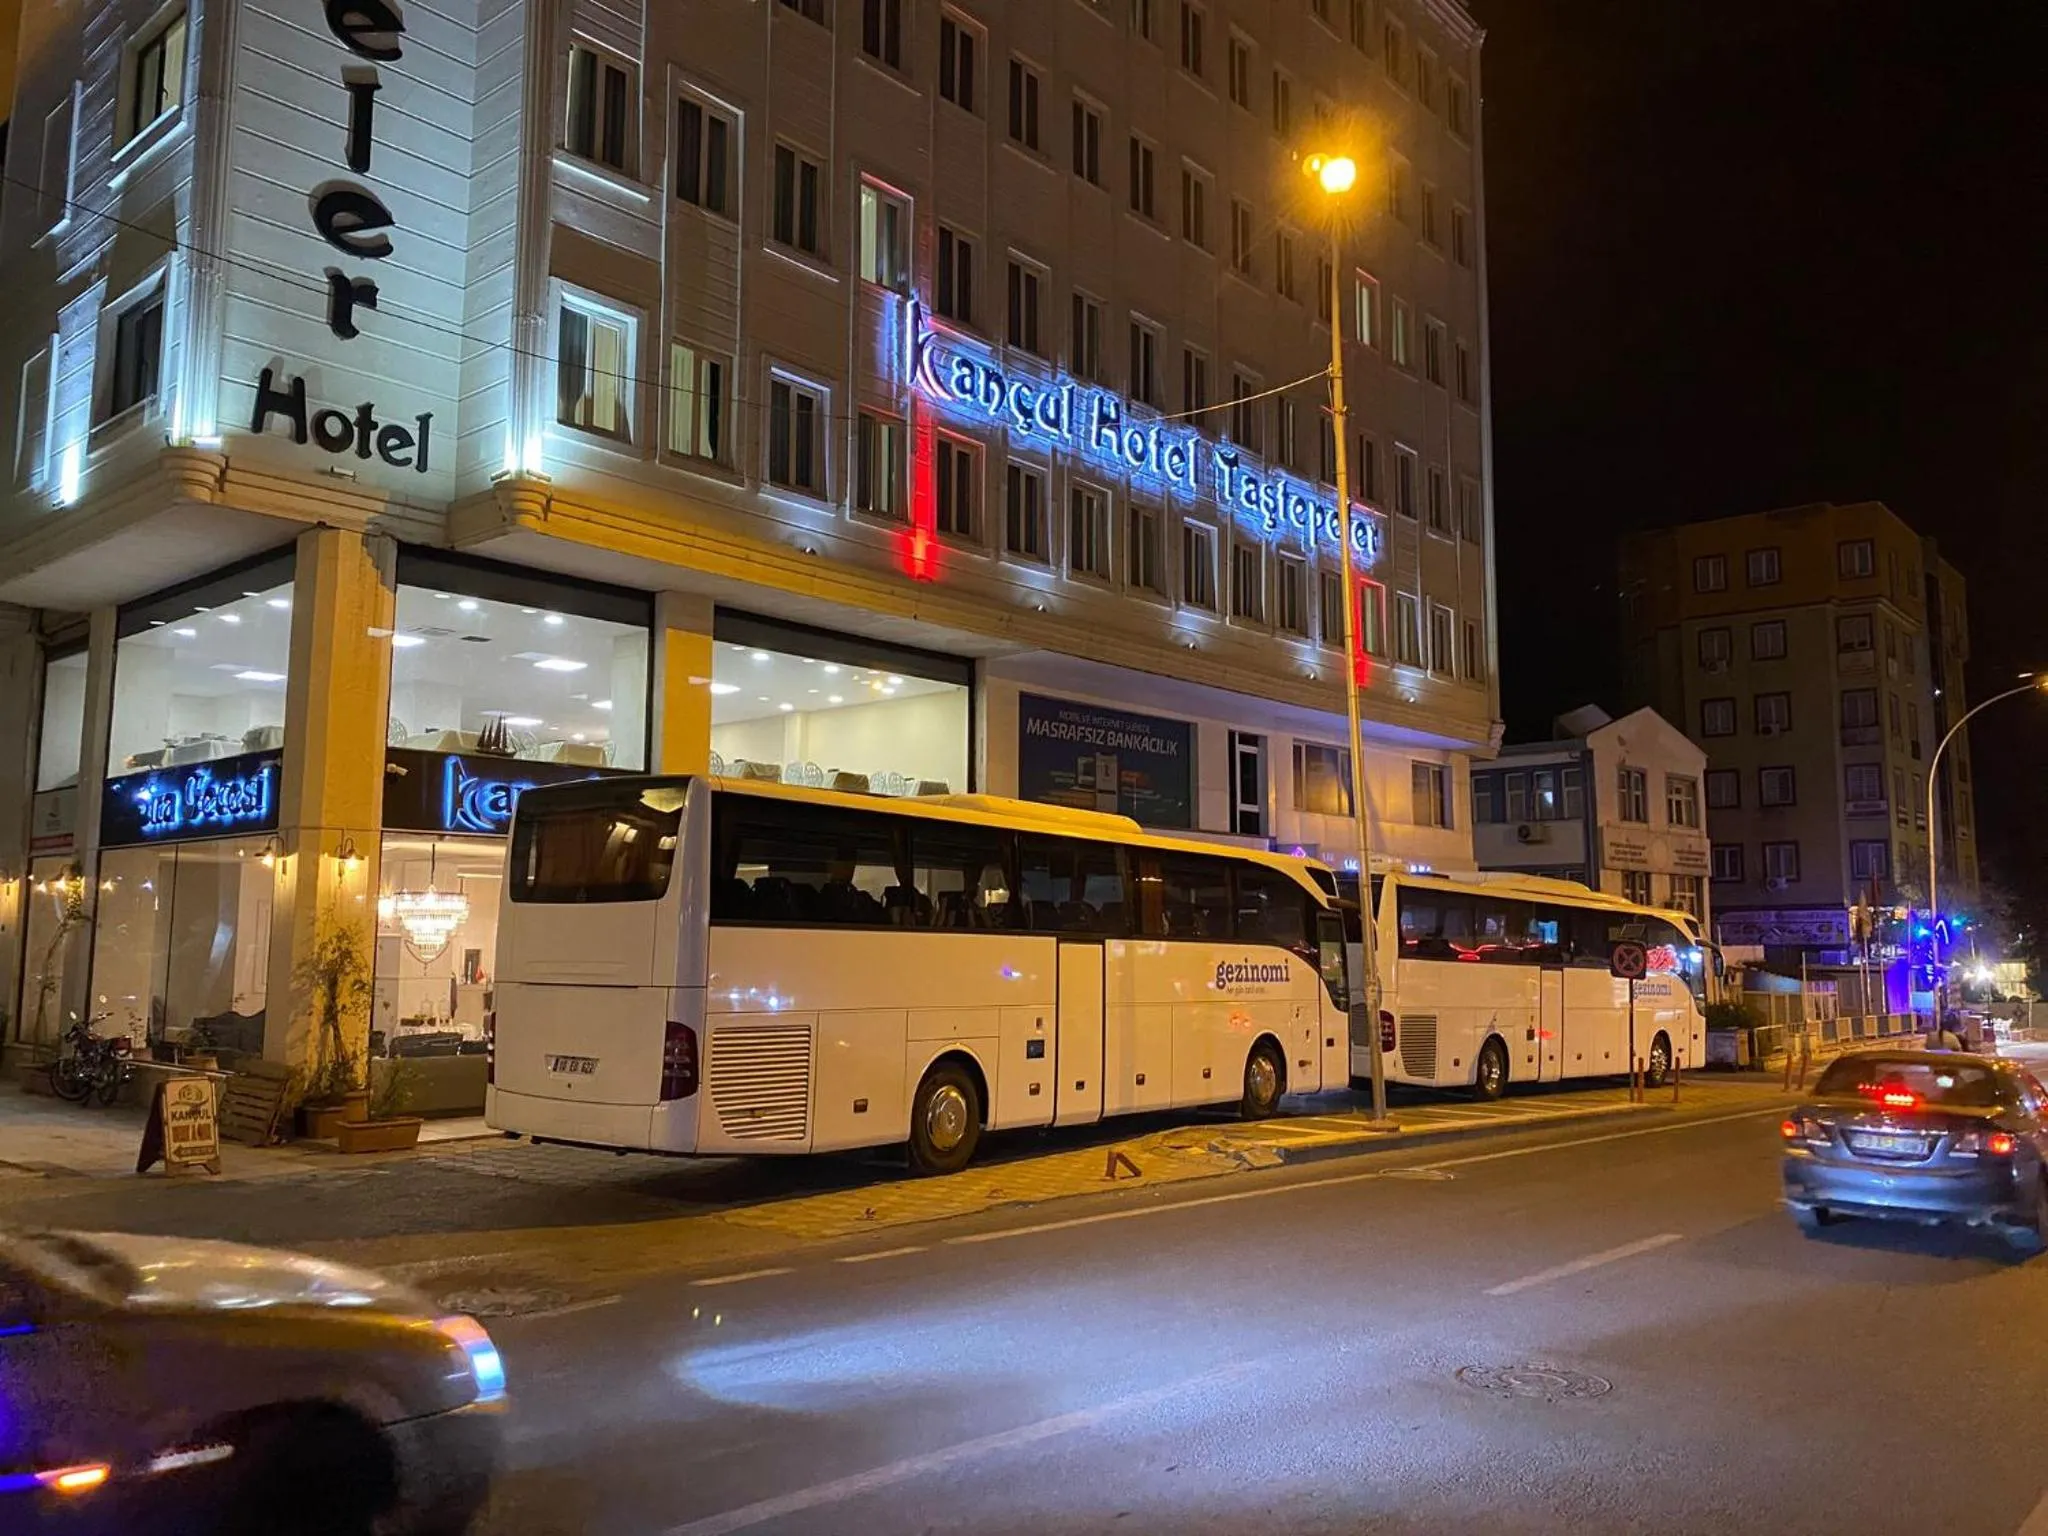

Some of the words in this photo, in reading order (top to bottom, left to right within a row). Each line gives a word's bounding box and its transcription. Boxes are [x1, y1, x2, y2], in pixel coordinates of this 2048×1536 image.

[251, 366, 434, 473] Hotel
[1091, 394, 1199, 488] Hotel
[1026, 717, 1104, 746] MASRAFSIZ
[1107, 731, 1179, 757] BANKACILIK
[1216, 957, 1290, 990] gezinomi
